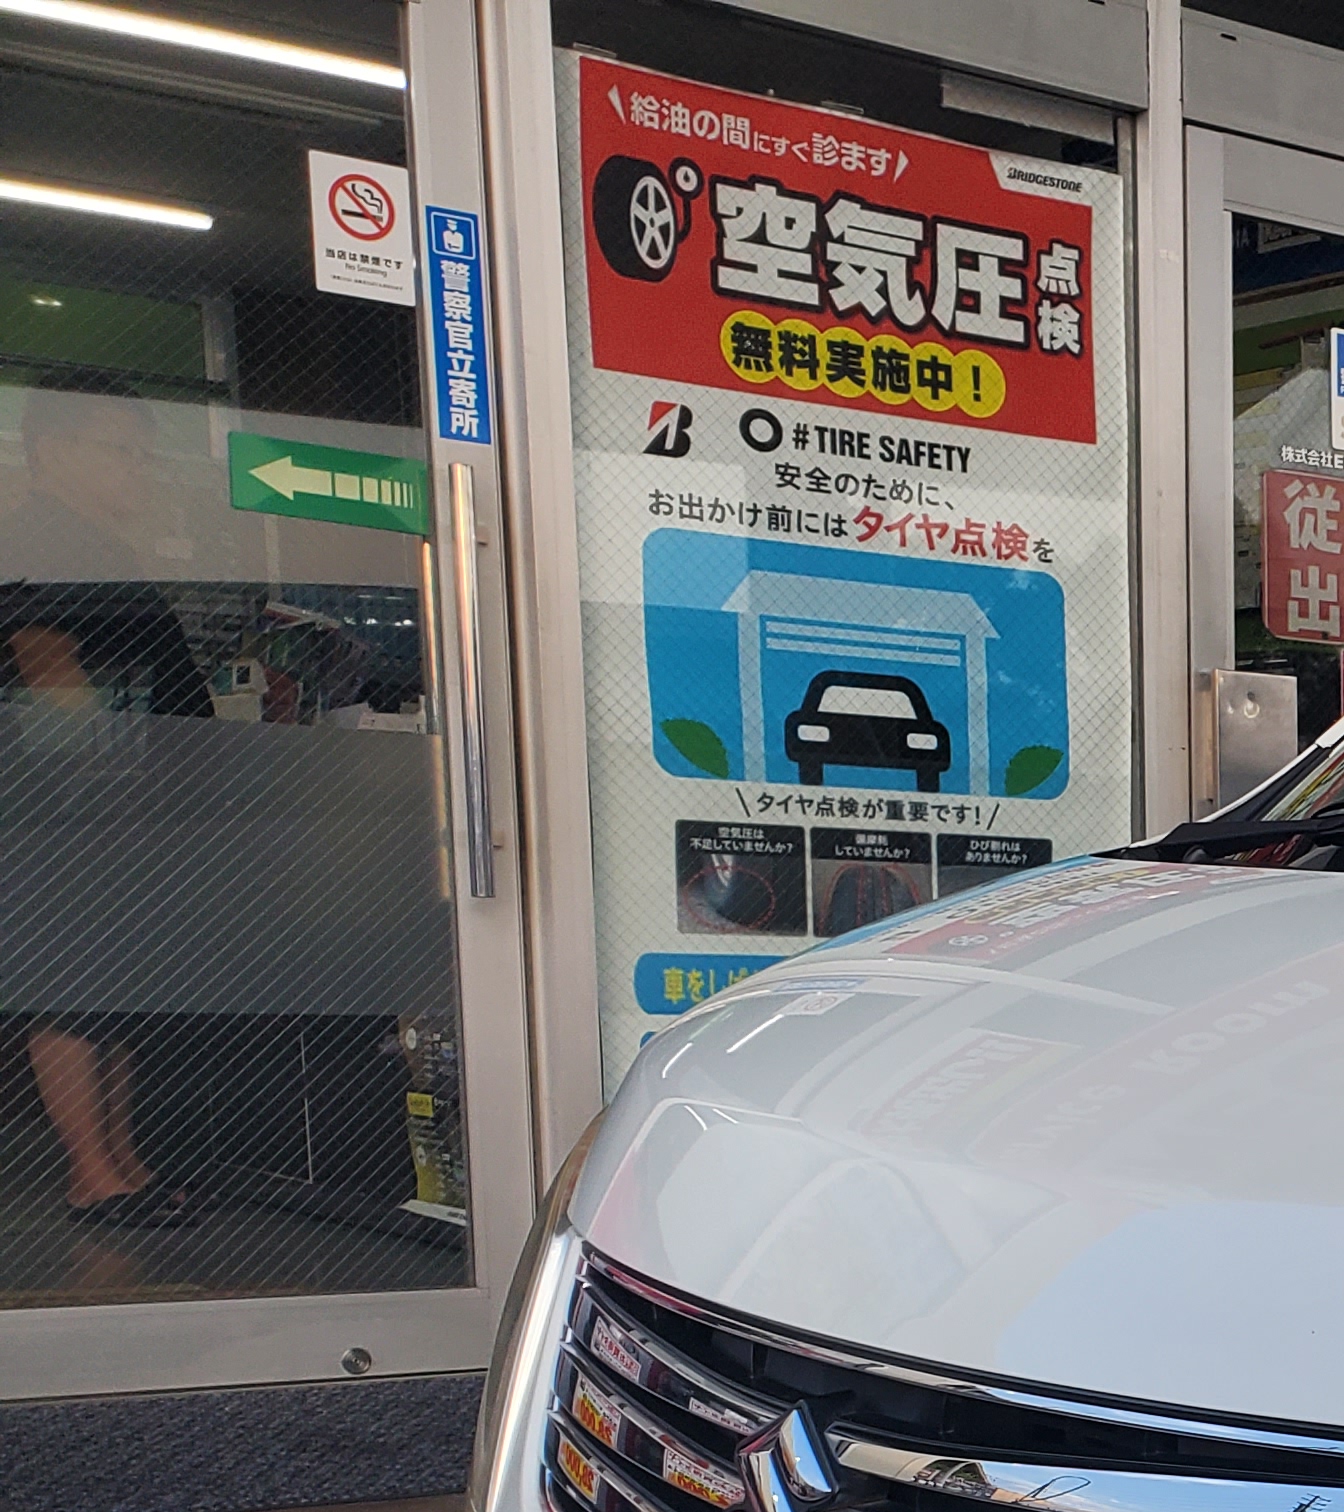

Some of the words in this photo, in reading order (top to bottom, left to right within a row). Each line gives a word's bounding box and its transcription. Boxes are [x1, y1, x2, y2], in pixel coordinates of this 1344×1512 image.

[629, 91, 893, 177] 給油の間にすぐ診ます
[1007, 167, 1082, 193] BRIDGESTONE
[714, 181, 1026, 344] 空気圧
[1036, 242, 1082, 355] 点検
[439, 259, 480, 439] 警察官立寄所
[729, 320, 983, 403] 無料実施中！
[878, 435, 972, 474] SAFETY
[647, 487, 1057, 564] お出かけ前にはタイヤ点検を
